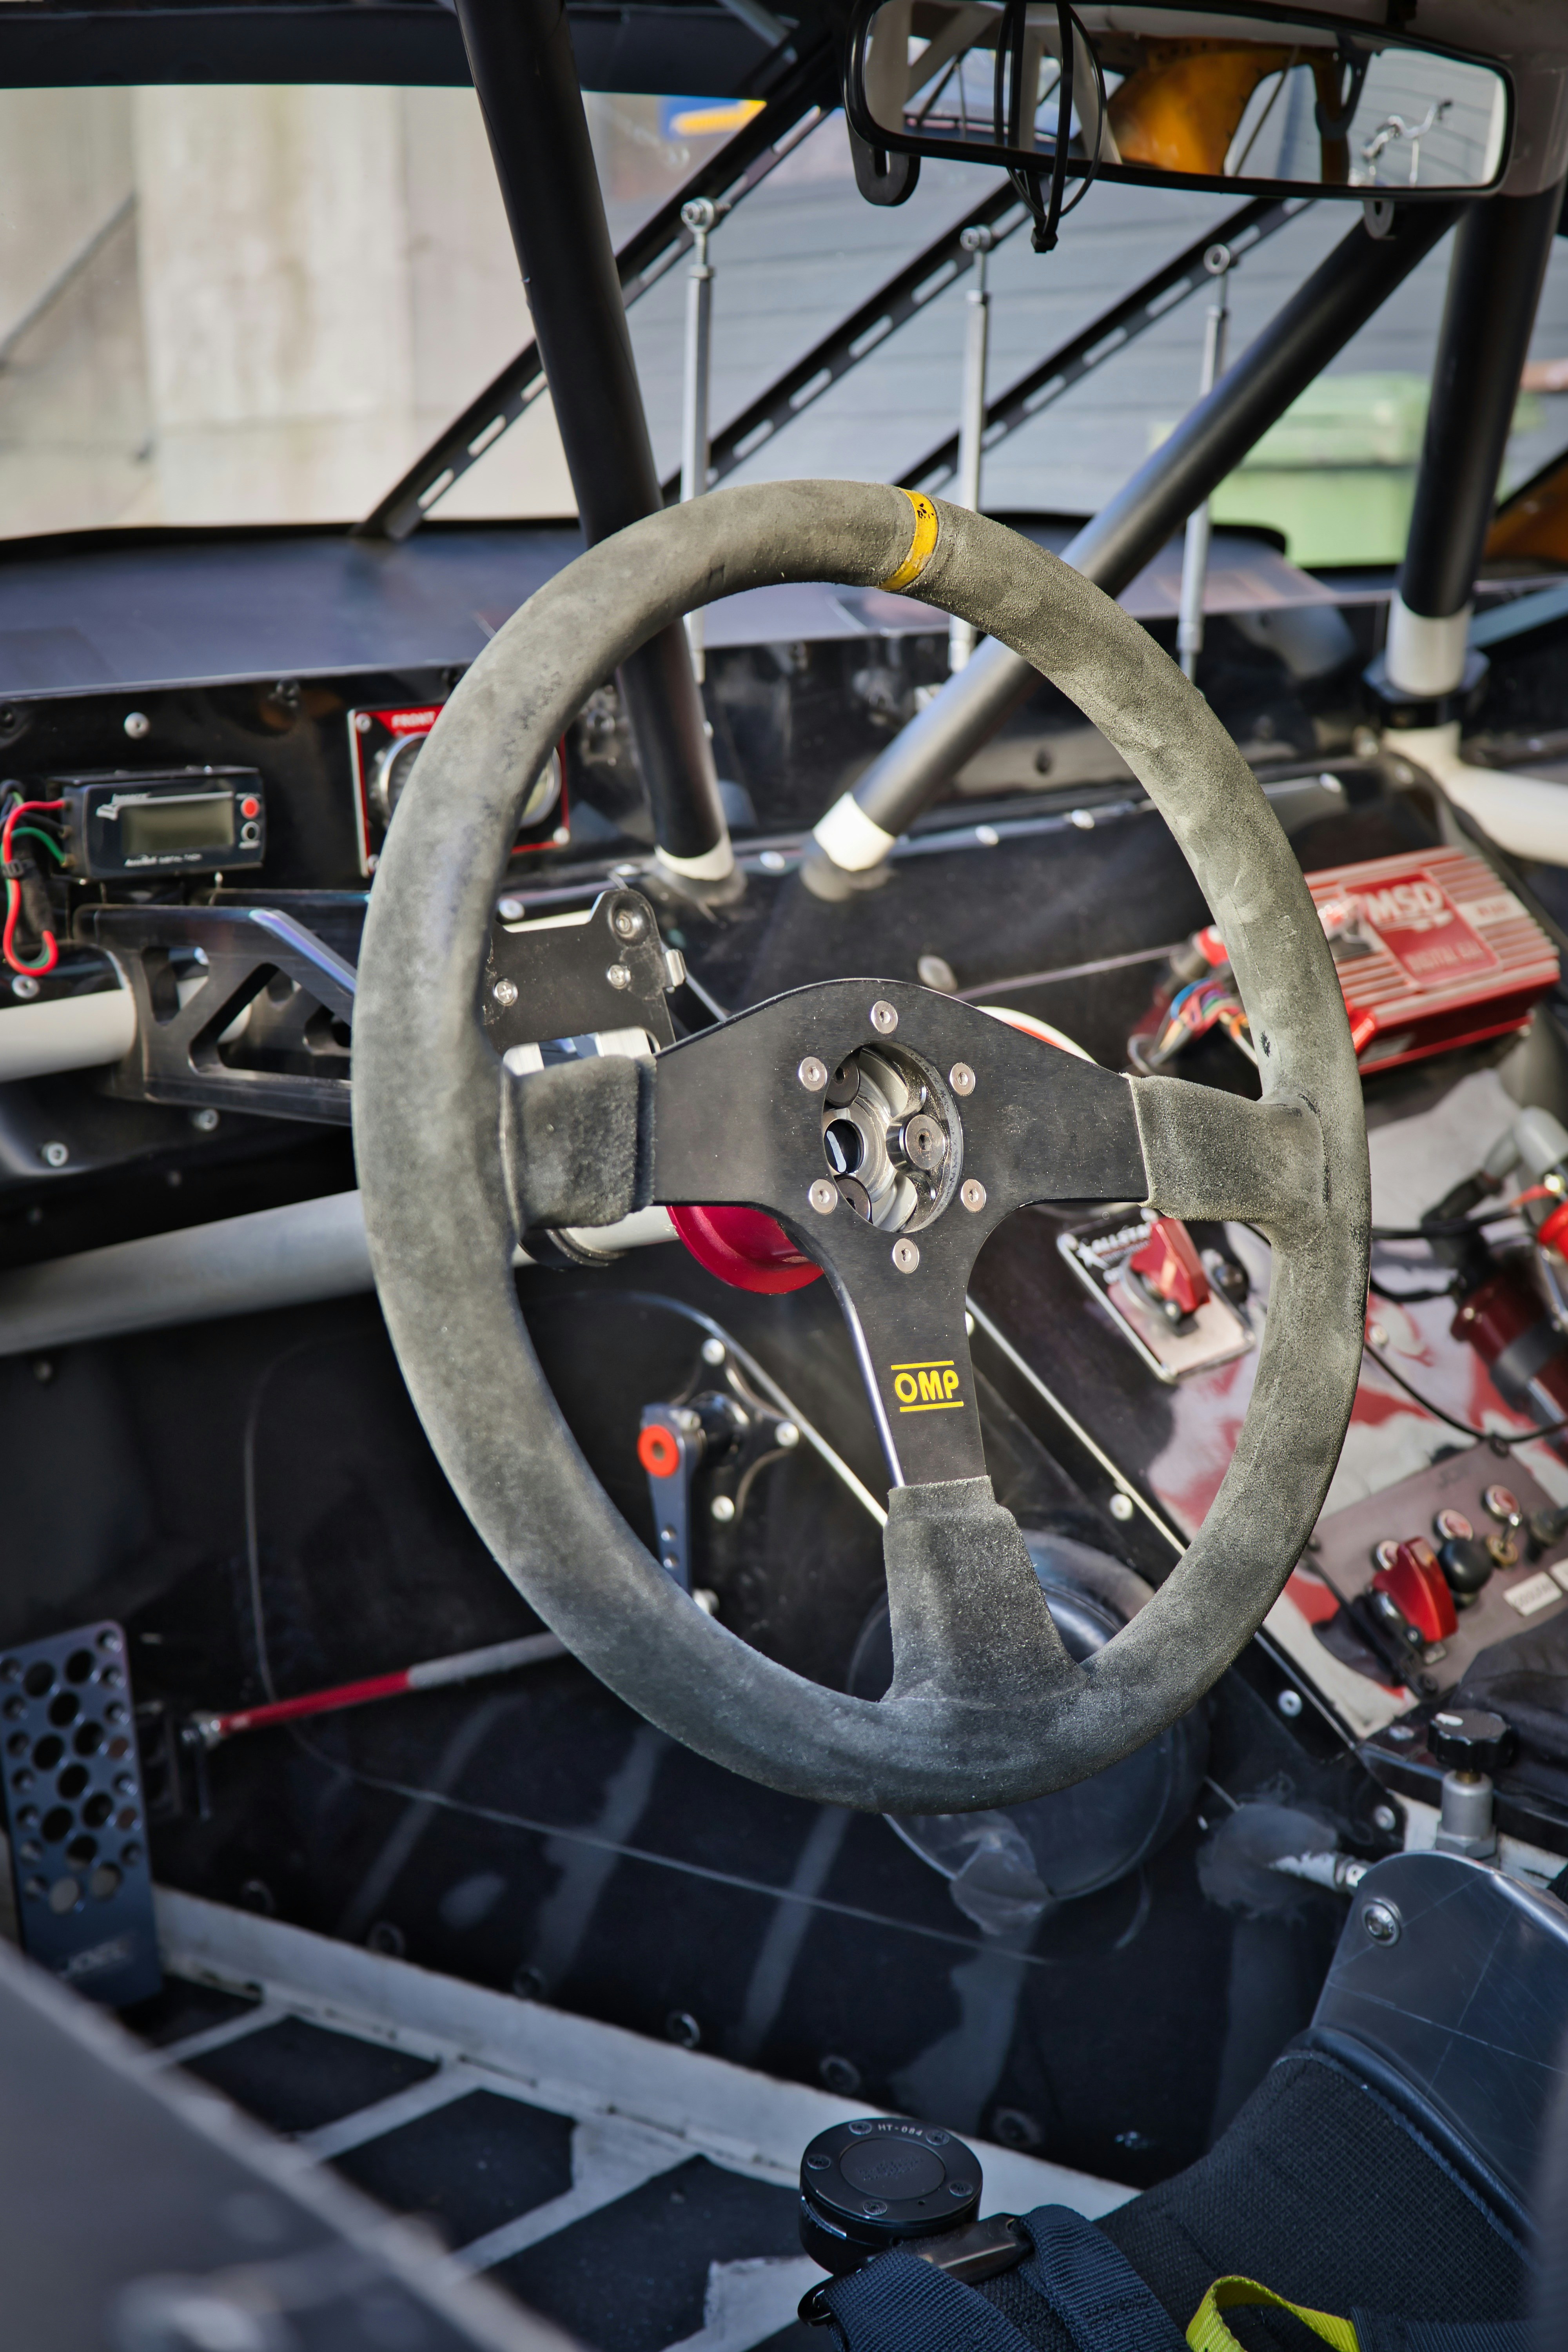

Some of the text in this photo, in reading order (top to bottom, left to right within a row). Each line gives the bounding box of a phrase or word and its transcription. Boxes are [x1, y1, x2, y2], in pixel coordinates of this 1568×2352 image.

[391, 711, 436, 728] FRONT
[1366, 881, 1444, 925] MSD
[895, 1370, 959, 1403] OMP
[878, 2123, 923, 2136] HT-084
